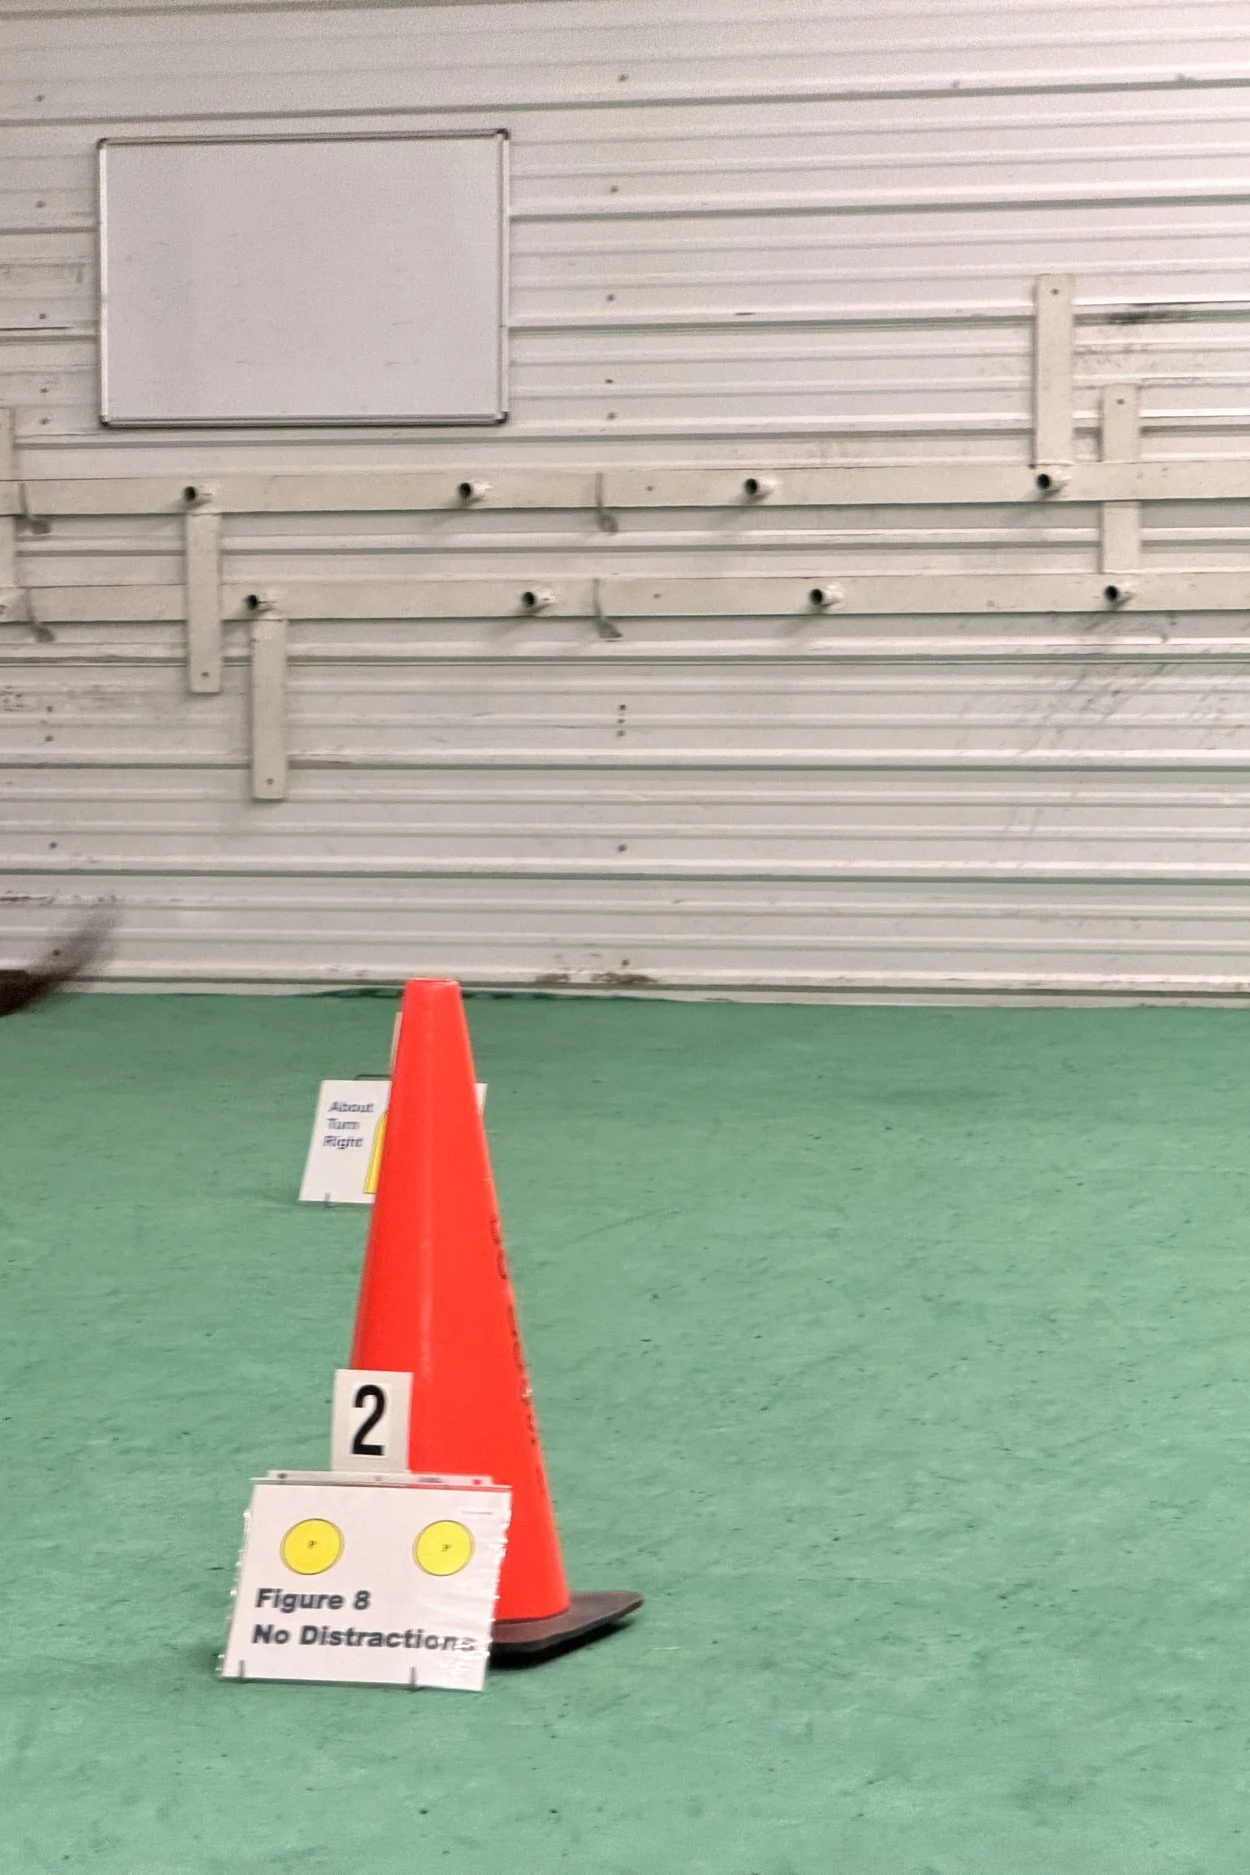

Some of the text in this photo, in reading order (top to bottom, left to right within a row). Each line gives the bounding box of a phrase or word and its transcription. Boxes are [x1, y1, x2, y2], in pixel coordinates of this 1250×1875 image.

[329, 1101, 374, 1113] About
[327, 1118, 360, 1130] Turn
[323, 1135, 363, 1149] Right
[351, 1384, 387, 1456] 2
[255, 1588, 371, 1613] Figure 8
[252, 1625, 290, 1644] No
